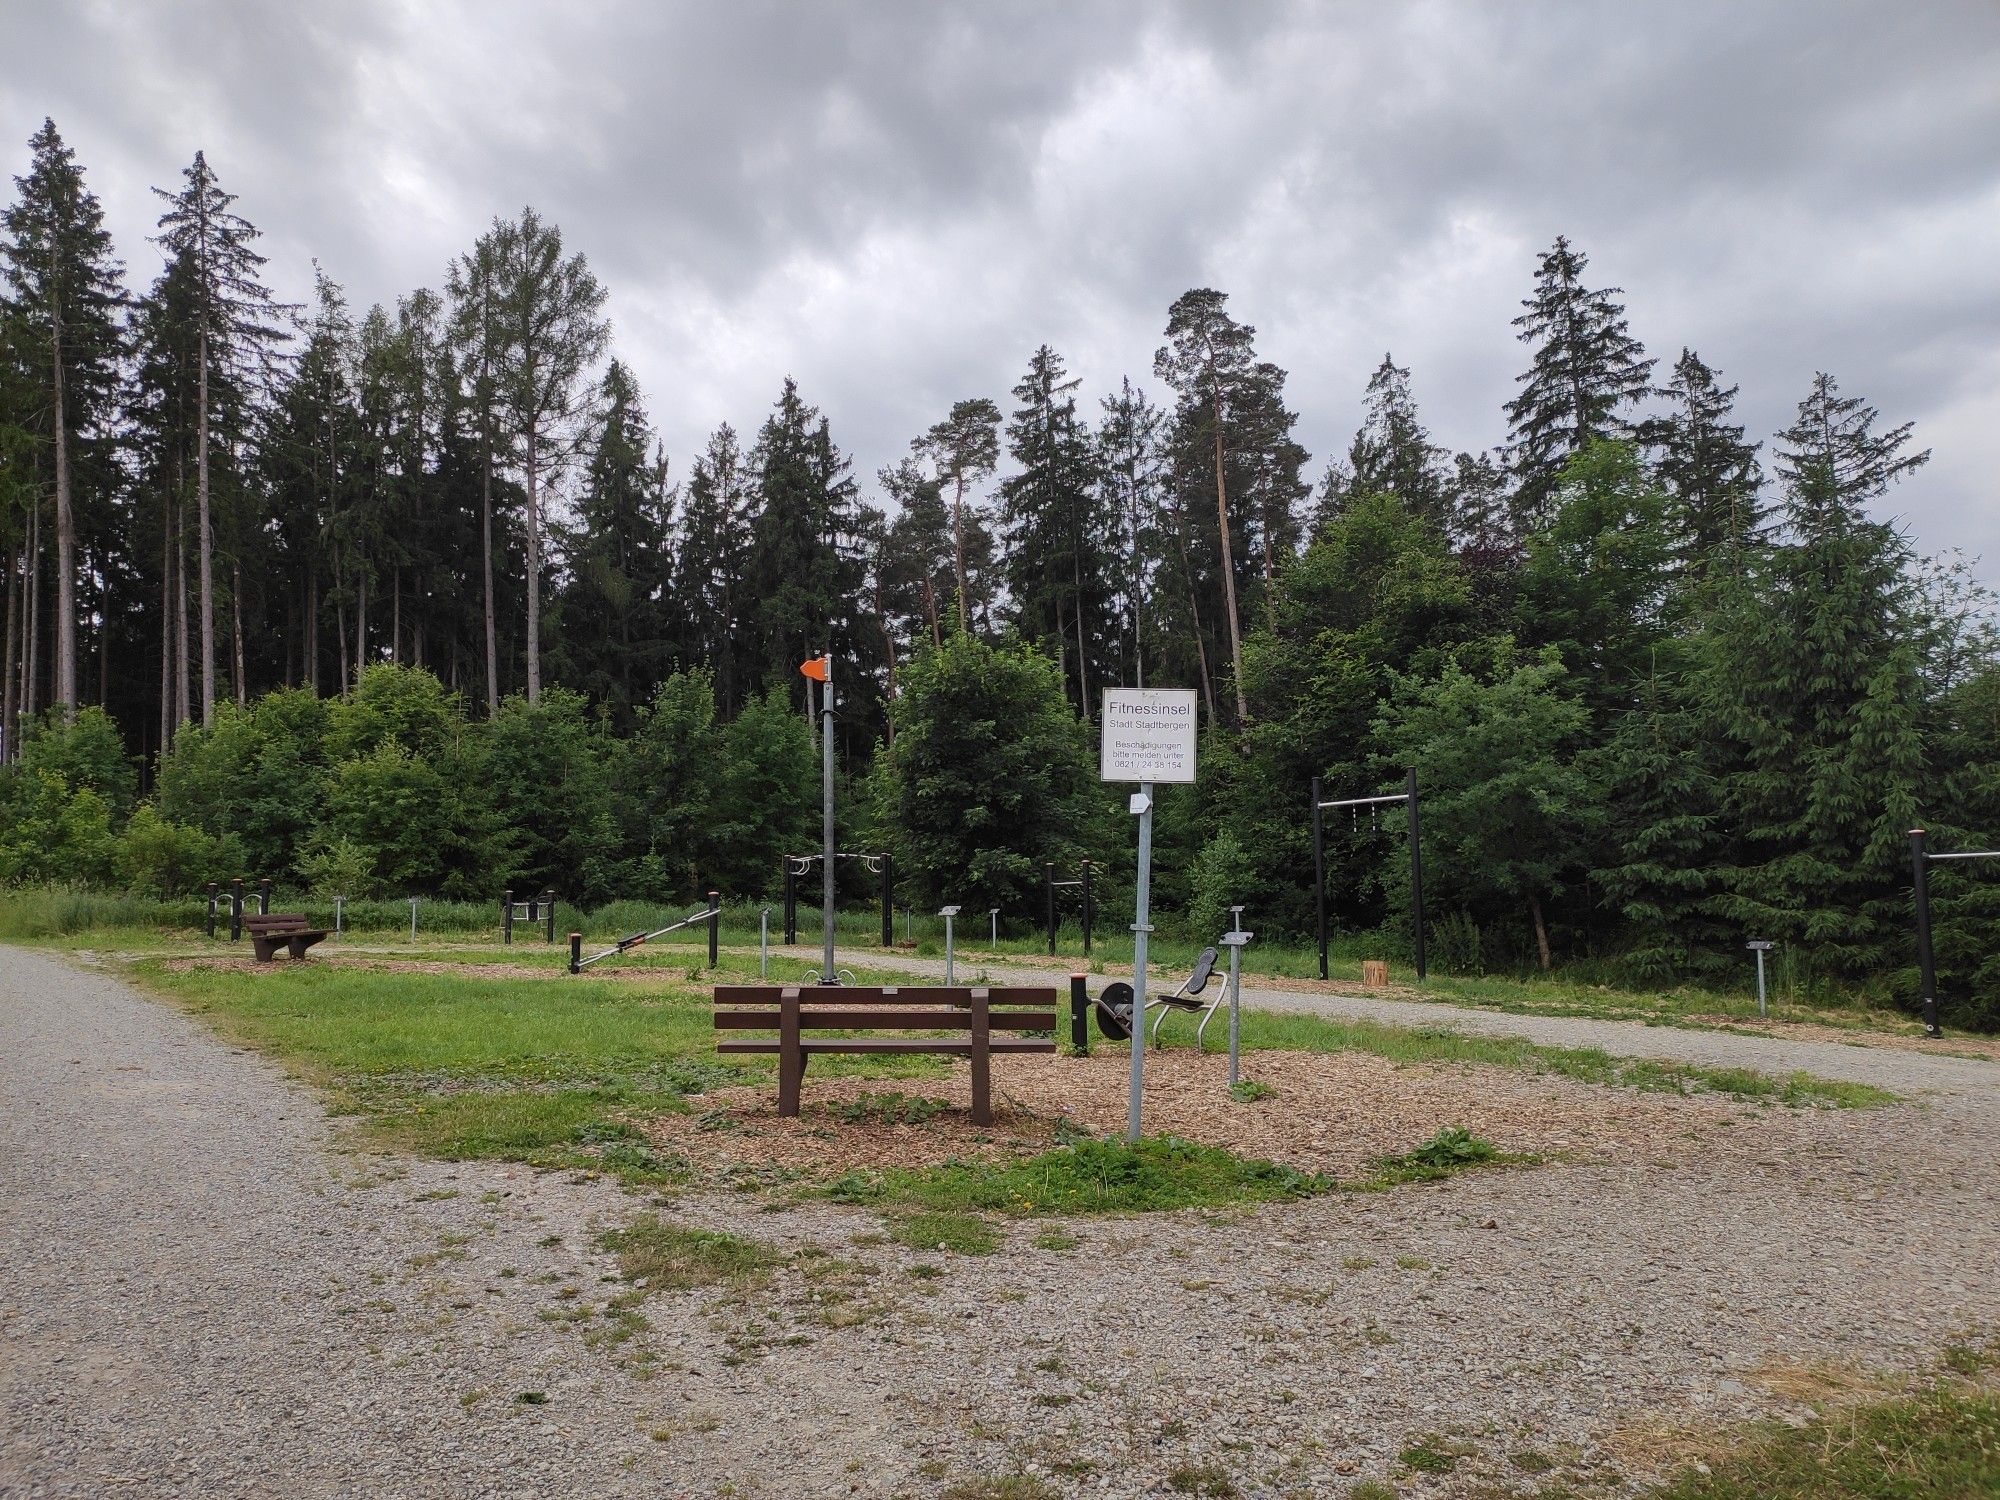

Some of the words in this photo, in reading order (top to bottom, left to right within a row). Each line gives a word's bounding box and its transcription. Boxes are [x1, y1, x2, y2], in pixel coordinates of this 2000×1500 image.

[1109, 701, 1190, 715] Fitnessinsel
[1109, 720, 1133, 728] Stadt
[1135, 720, 1190, 732] Stadtbergen
[1112, 750, 1130, 758] bitte
[1132, 751, 1162, 759] melden
[1114, 760, 1134, 768] 0821
[1142, 761, 1152, 769] 24
[1167, 761, 1182, 769] 154
